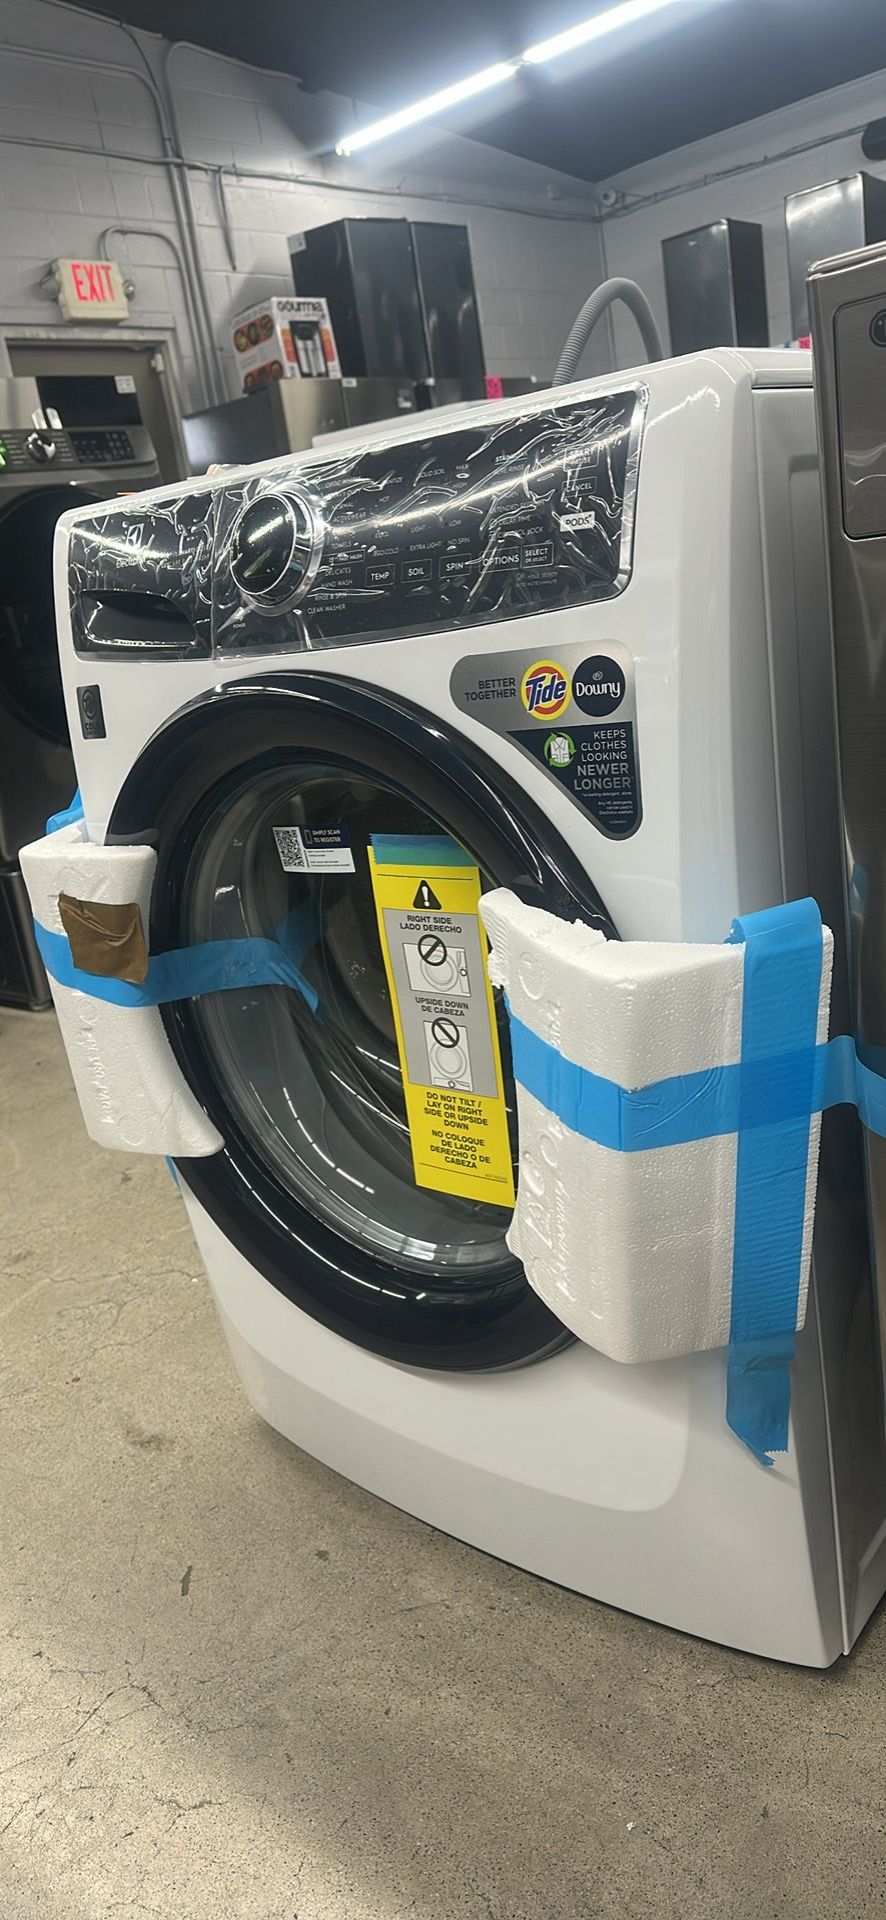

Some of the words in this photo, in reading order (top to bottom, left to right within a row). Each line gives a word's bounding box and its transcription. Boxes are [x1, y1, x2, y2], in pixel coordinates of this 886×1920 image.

[71, 262, 116, 303] EXIT
[525, 548, 549, 557] SELECT
[446, 562, 464, 572] SPIN
[482, 556, 520, 566] OPTIONS
[370, 572, 390, 581] TEMP
[408, 568, 424, 576] SOIL
[307, 606, 324, 614] CLEAN
[324, 604, 346, 612] WASHER
[478, 678, 516, 690] BETTER
[576, 682, 621, 698] Downy
[464, 688, 517, 702] TOGETHER
[525, 672, 568, 713] Tide
[594, 728, 626, 740] KEEPS
[580, 740, 627, 751] CLOTHES
[582, 751, 628, 762] LOOKING
[577, 763, 629, 777] NEWER
[406, 914, 431, 924] RIGHT
[433, 916, 453, 925] SIDE
[400, 922, 421, 931] LADO
[422, 924, 463, 934] DERECHO
[415, 996, 443, 1007] UPSIDE
[444, 1000, 469, 1010] DOWN
[421, 1004, 433, 1012] DE
[434, 1006, 465, 1017] CABEZA
[426, 1092, 438, 1100] DO
[440, 1094, 457, 1103] NOT
[458, 1096, 476, 1107] TILT
[426, 1100, 442, 1110] LAY
[444, 1103, 456, 1112] ON
[458, 1106, 483, 1116] RIGHT
[424, 1107, 442, 1117] SIDE
[444, 1111, 456, 1120] OR
[458, 1114, 488, 1126] UPSIDE
[444, 1119, 470, 1130] DOWN
[432, 1129, 444, 1138] NO
[445, 1132, 485, 1146] COLOQUE
[441, 1140, 453, 1148] DE
[454, 1142, 477, 1152] LADO
[430, 1144, 469, 1158] DERECHO
[470, 1152, 478, 1160] O
[479, 1155, 491, 1164] DE
[444, 1156, 478, 1169] CABEZA
